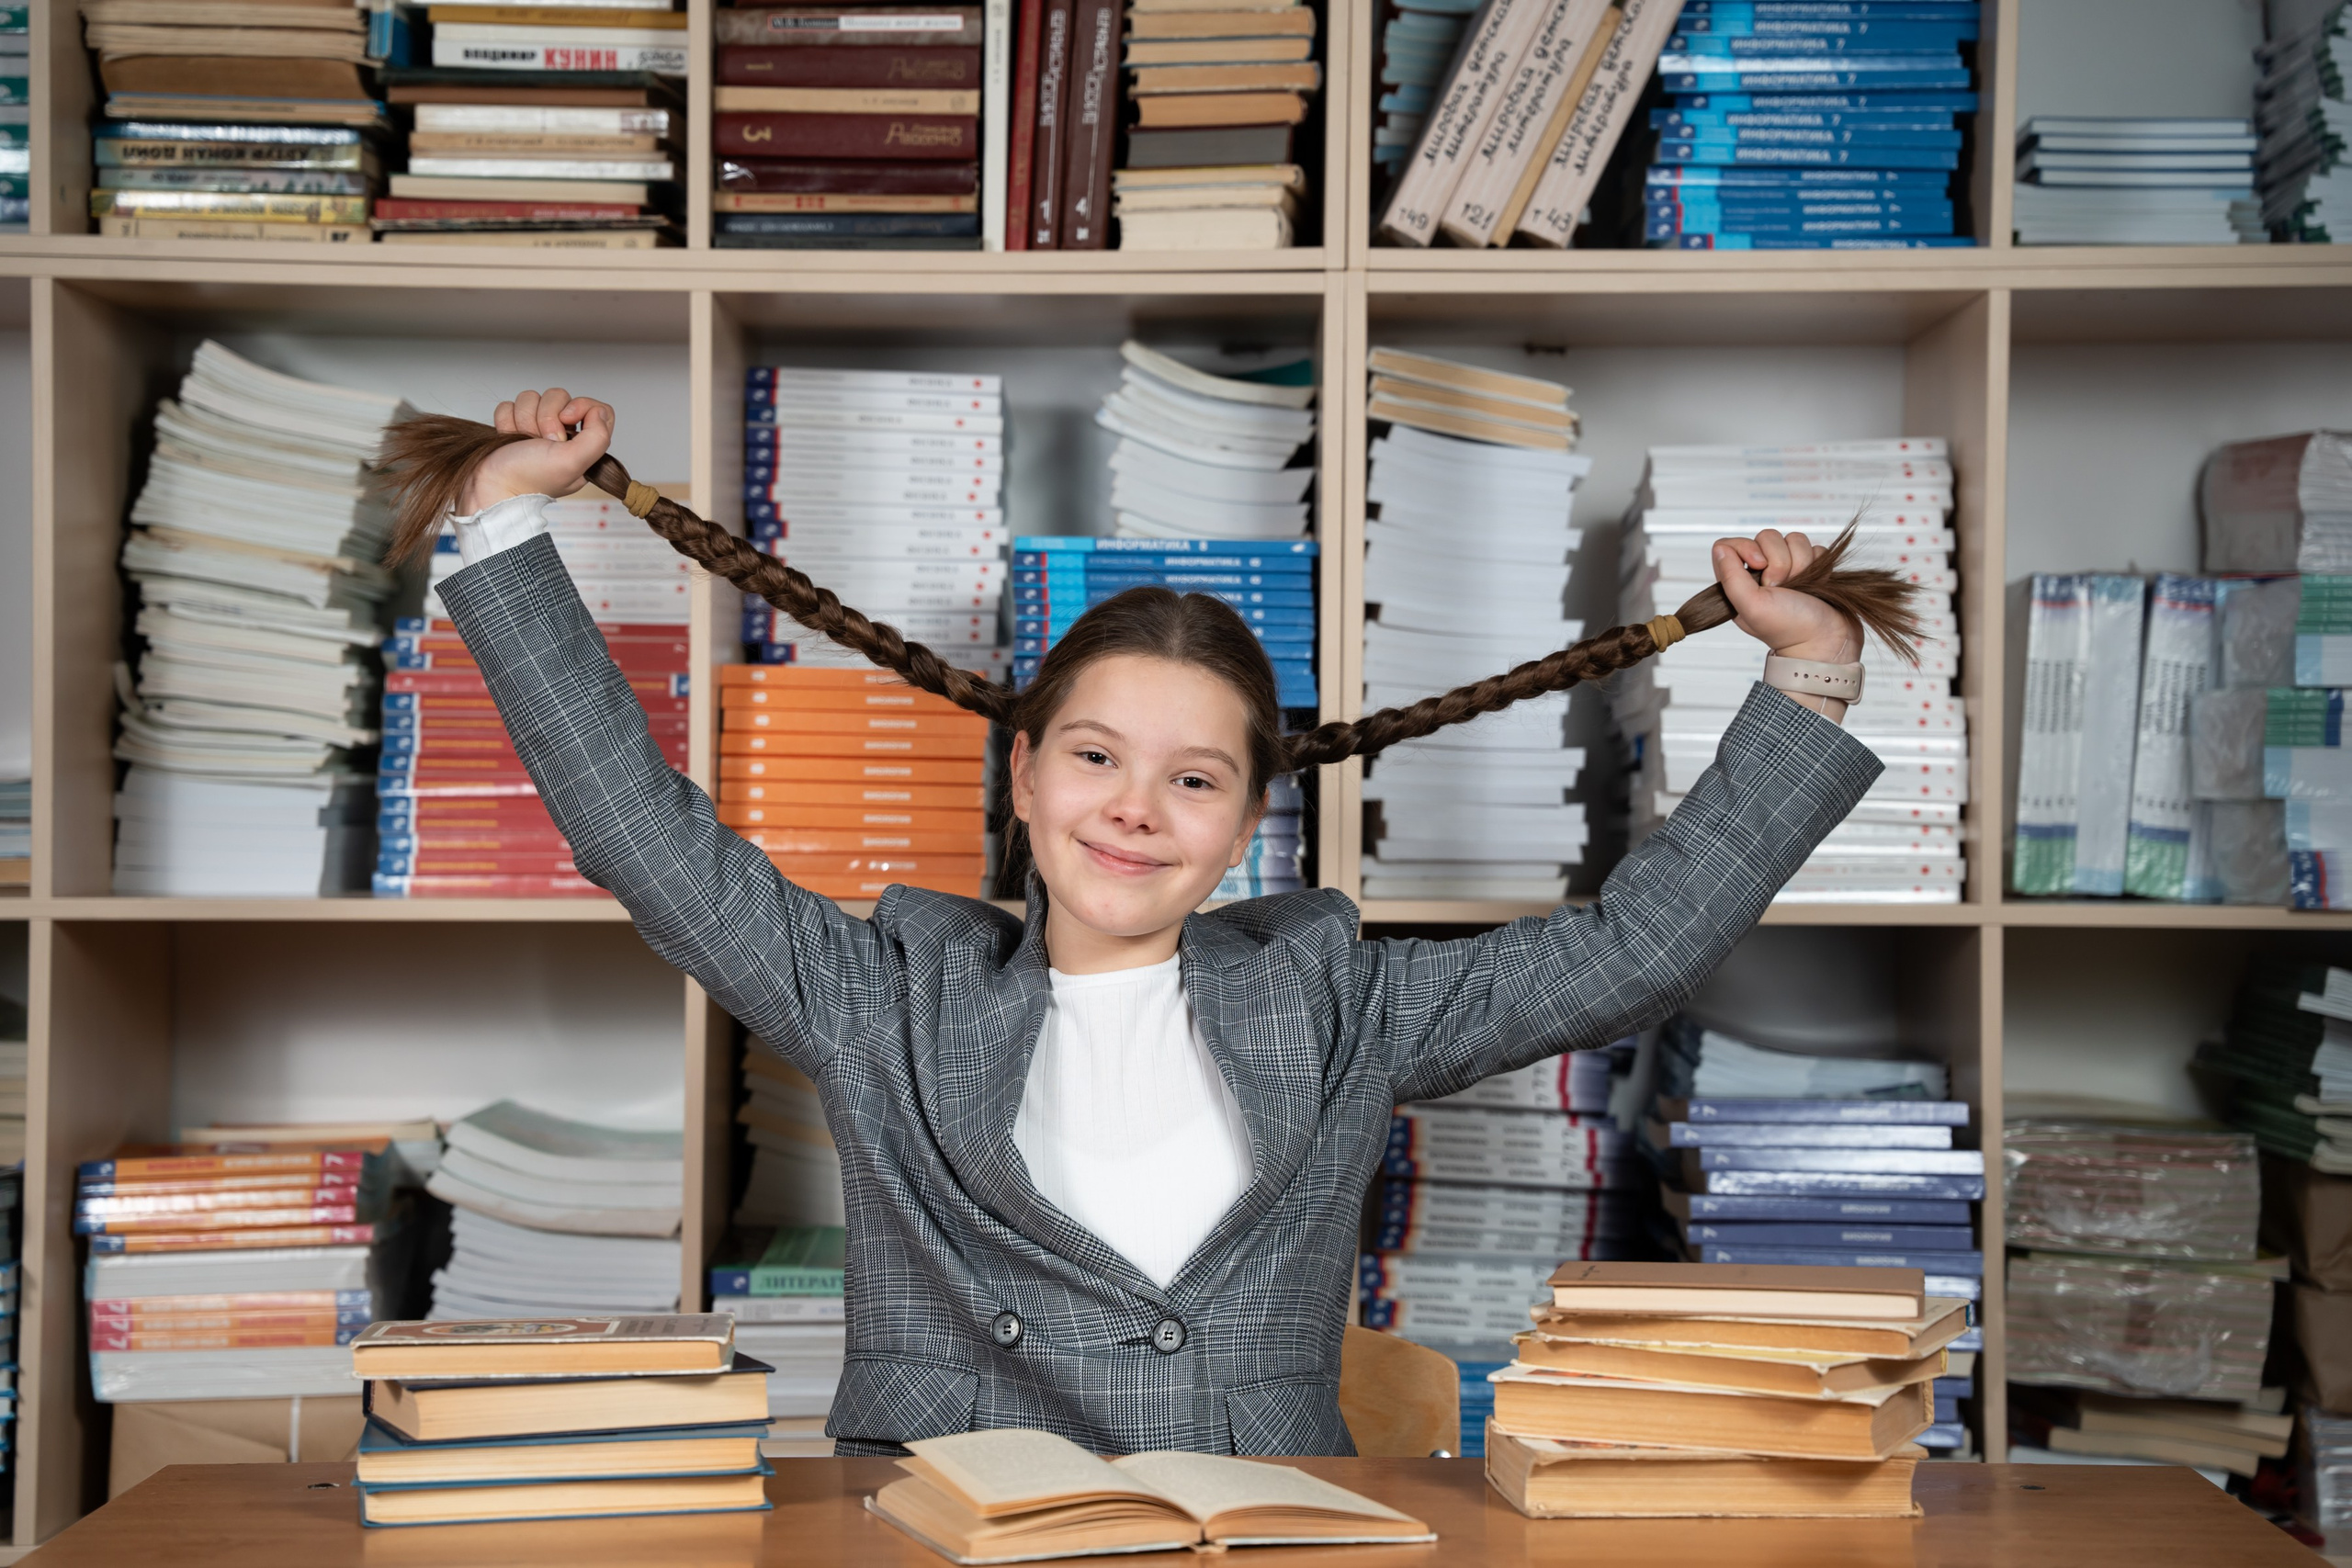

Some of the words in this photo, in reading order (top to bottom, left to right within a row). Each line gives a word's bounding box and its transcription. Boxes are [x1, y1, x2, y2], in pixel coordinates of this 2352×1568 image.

[545, 48, 617, 71] КУНИН
[742, 126, 772, 141] 3
[123, 144, 175, 159] ДОЙЛ
[182, 145, 246, 159] КОНАН
[1095, 539, 1191, 552] ИНФОРМАТИКА
[1199, 540, 1208, 551] 8
